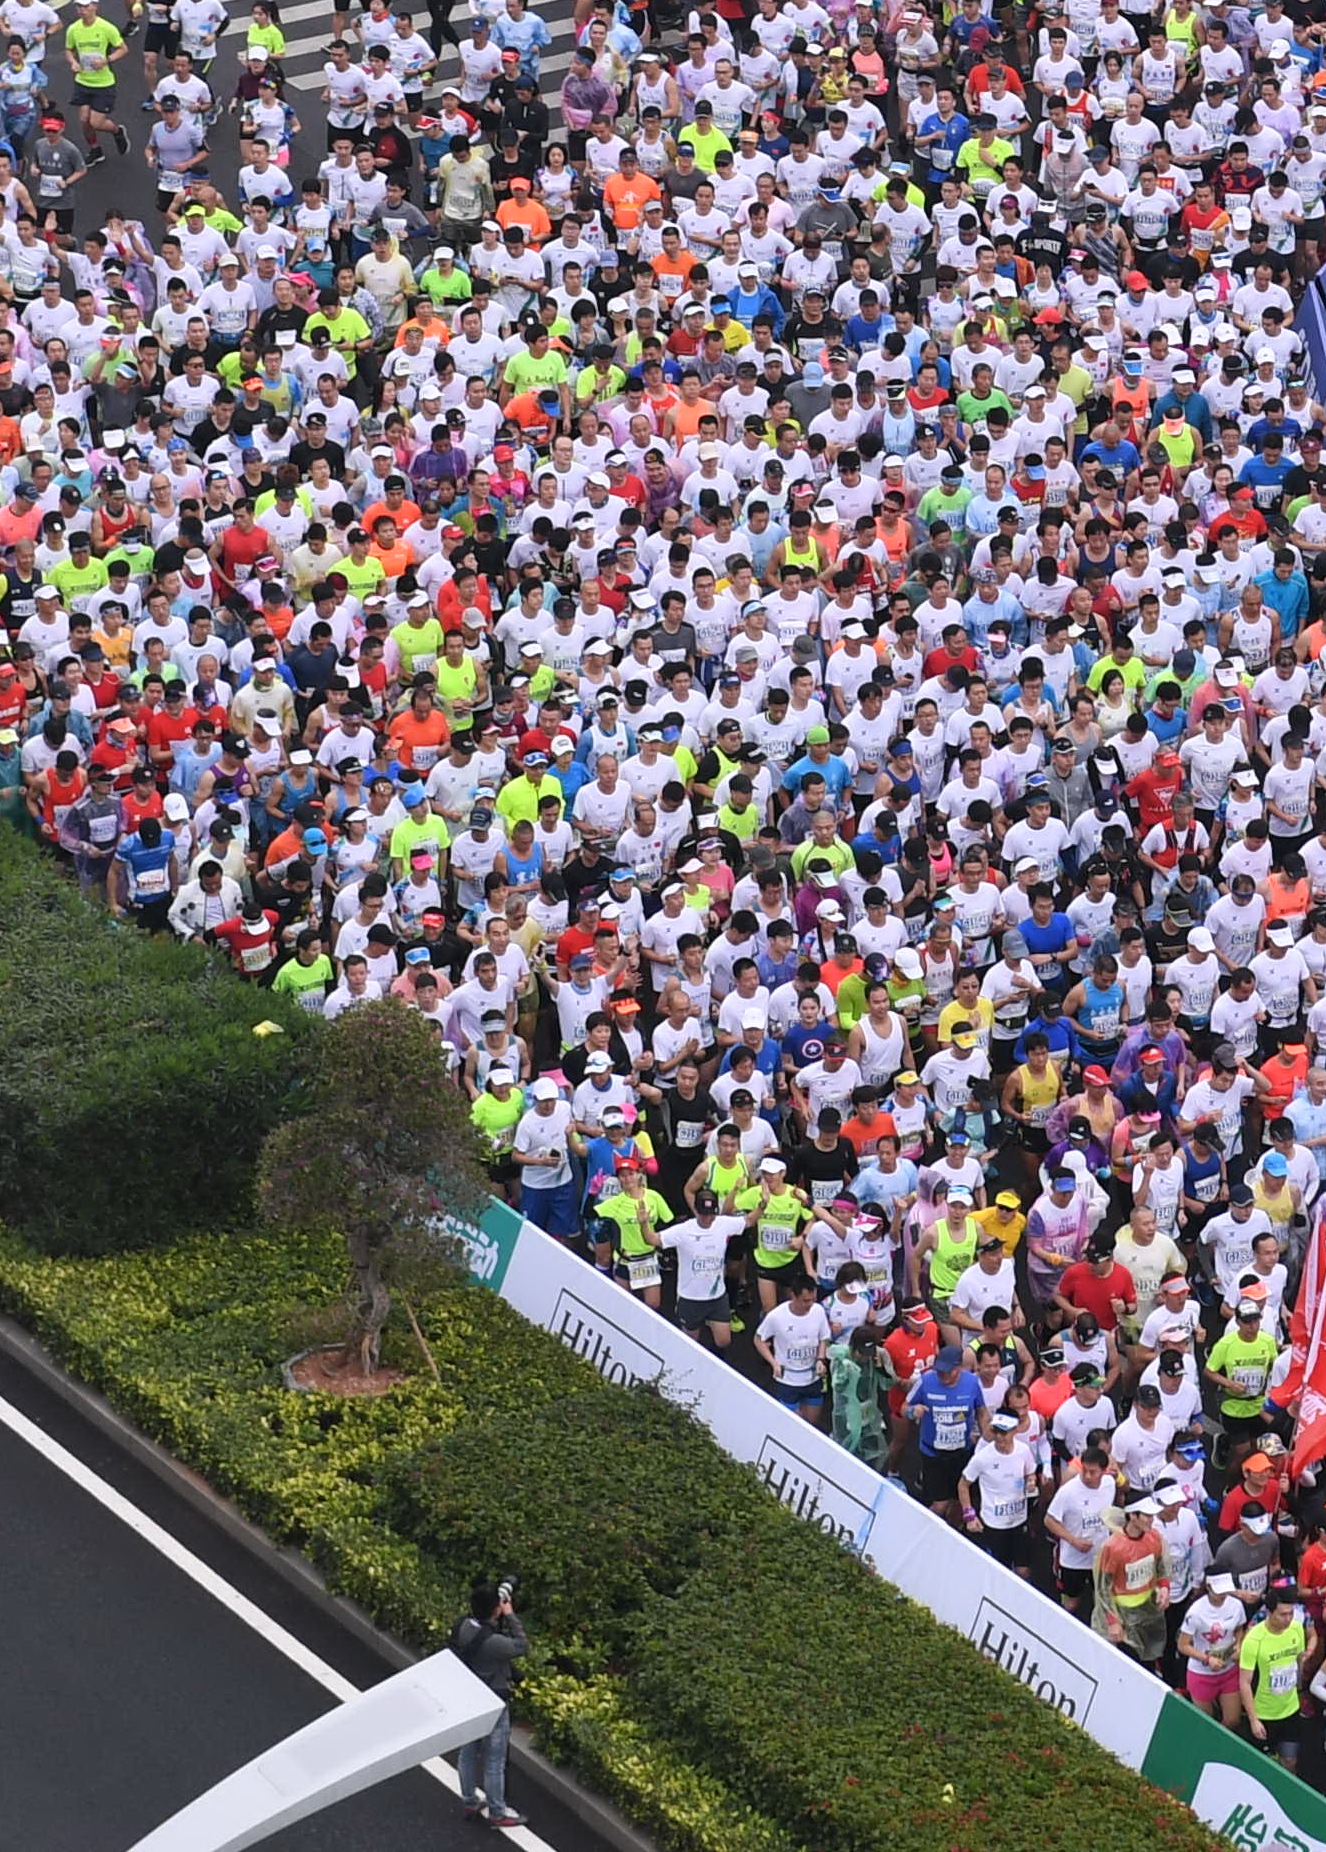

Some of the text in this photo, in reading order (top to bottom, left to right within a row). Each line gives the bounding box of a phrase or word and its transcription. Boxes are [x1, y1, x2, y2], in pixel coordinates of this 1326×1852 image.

[559, 1310, 648, 1388] Hilton
[764, 1457, 855, 1546] Hilton
[979, 1620, 1077, 1720] Hilton
